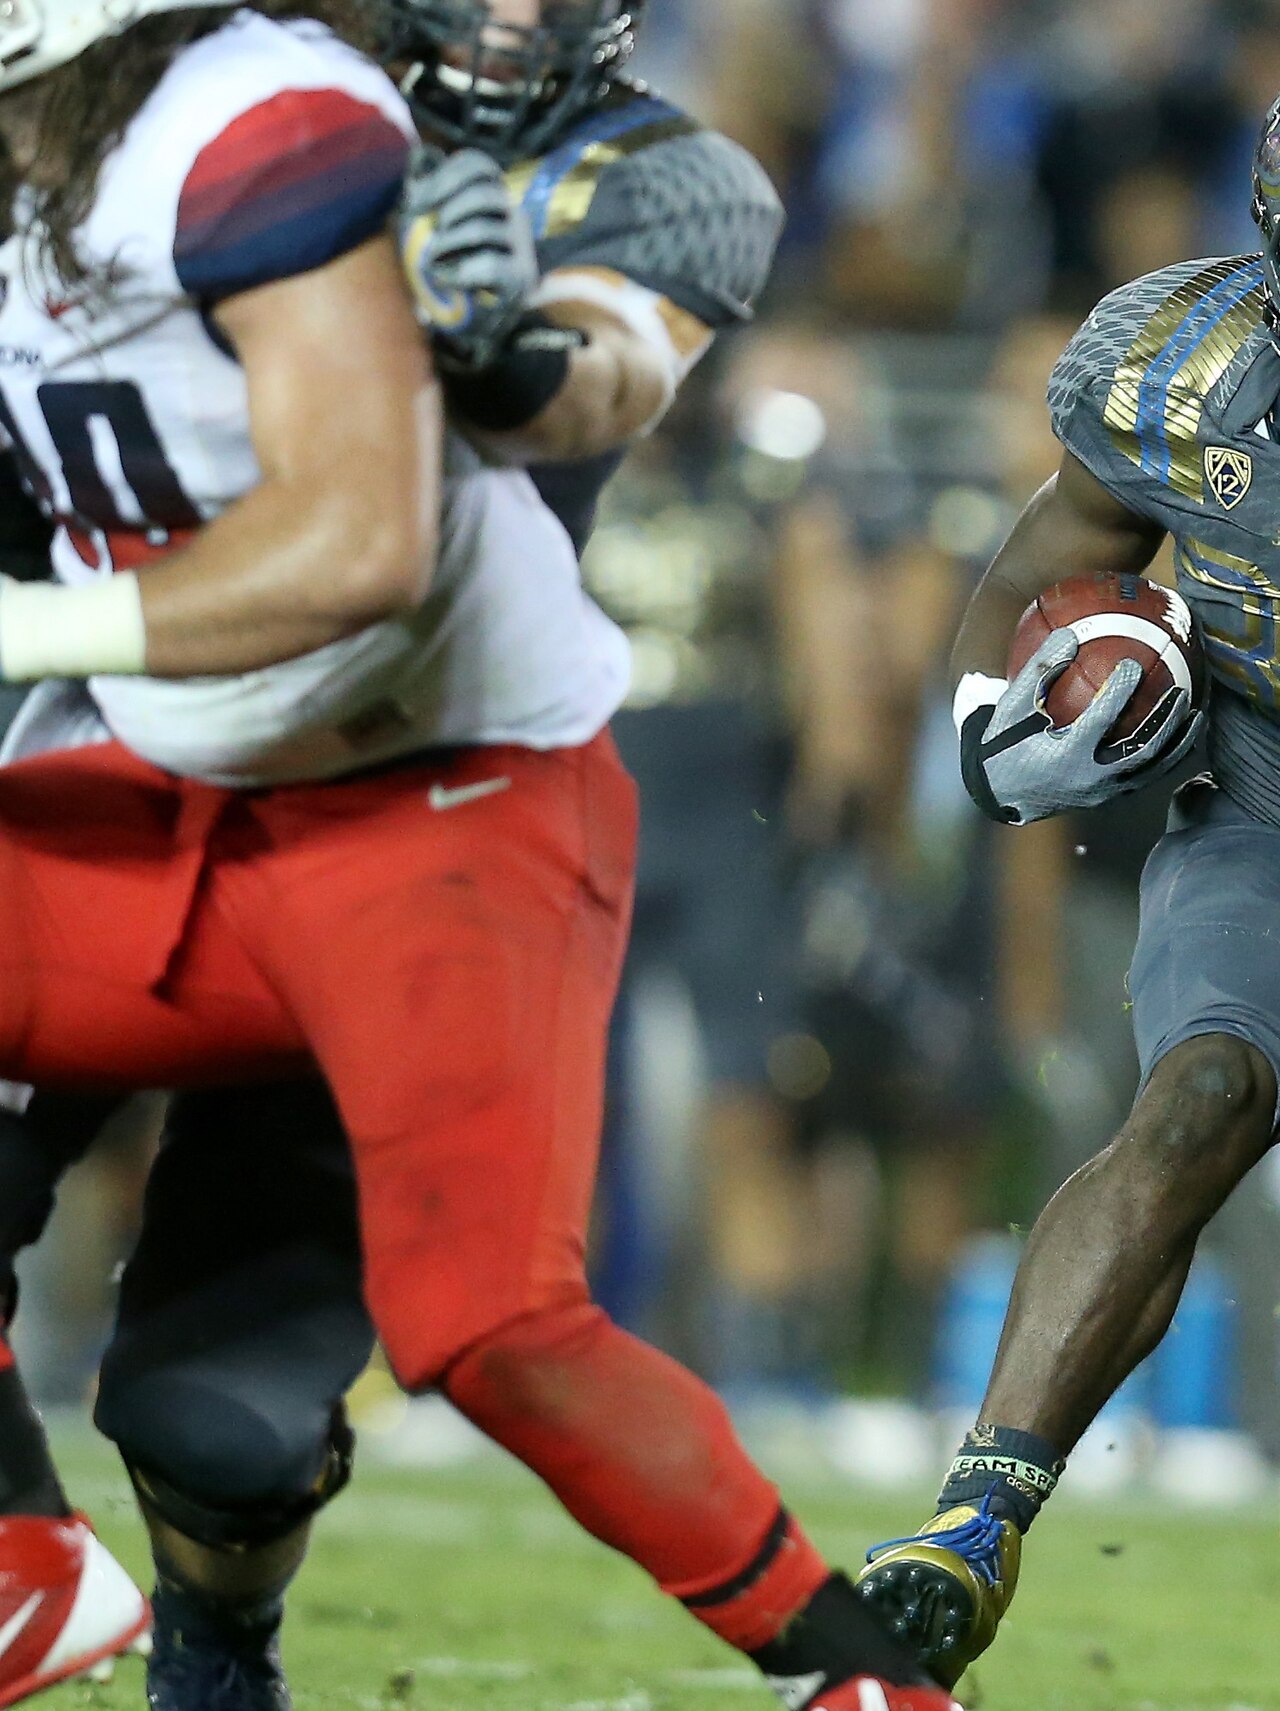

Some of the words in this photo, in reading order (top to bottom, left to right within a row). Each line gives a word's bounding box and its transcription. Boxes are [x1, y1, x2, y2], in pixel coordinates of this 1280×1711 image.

[1208, 450, 1249, 485] PAC
[1217, 473, 1240, 497] 12
[954, 1458, 1017, 1475] EAM
